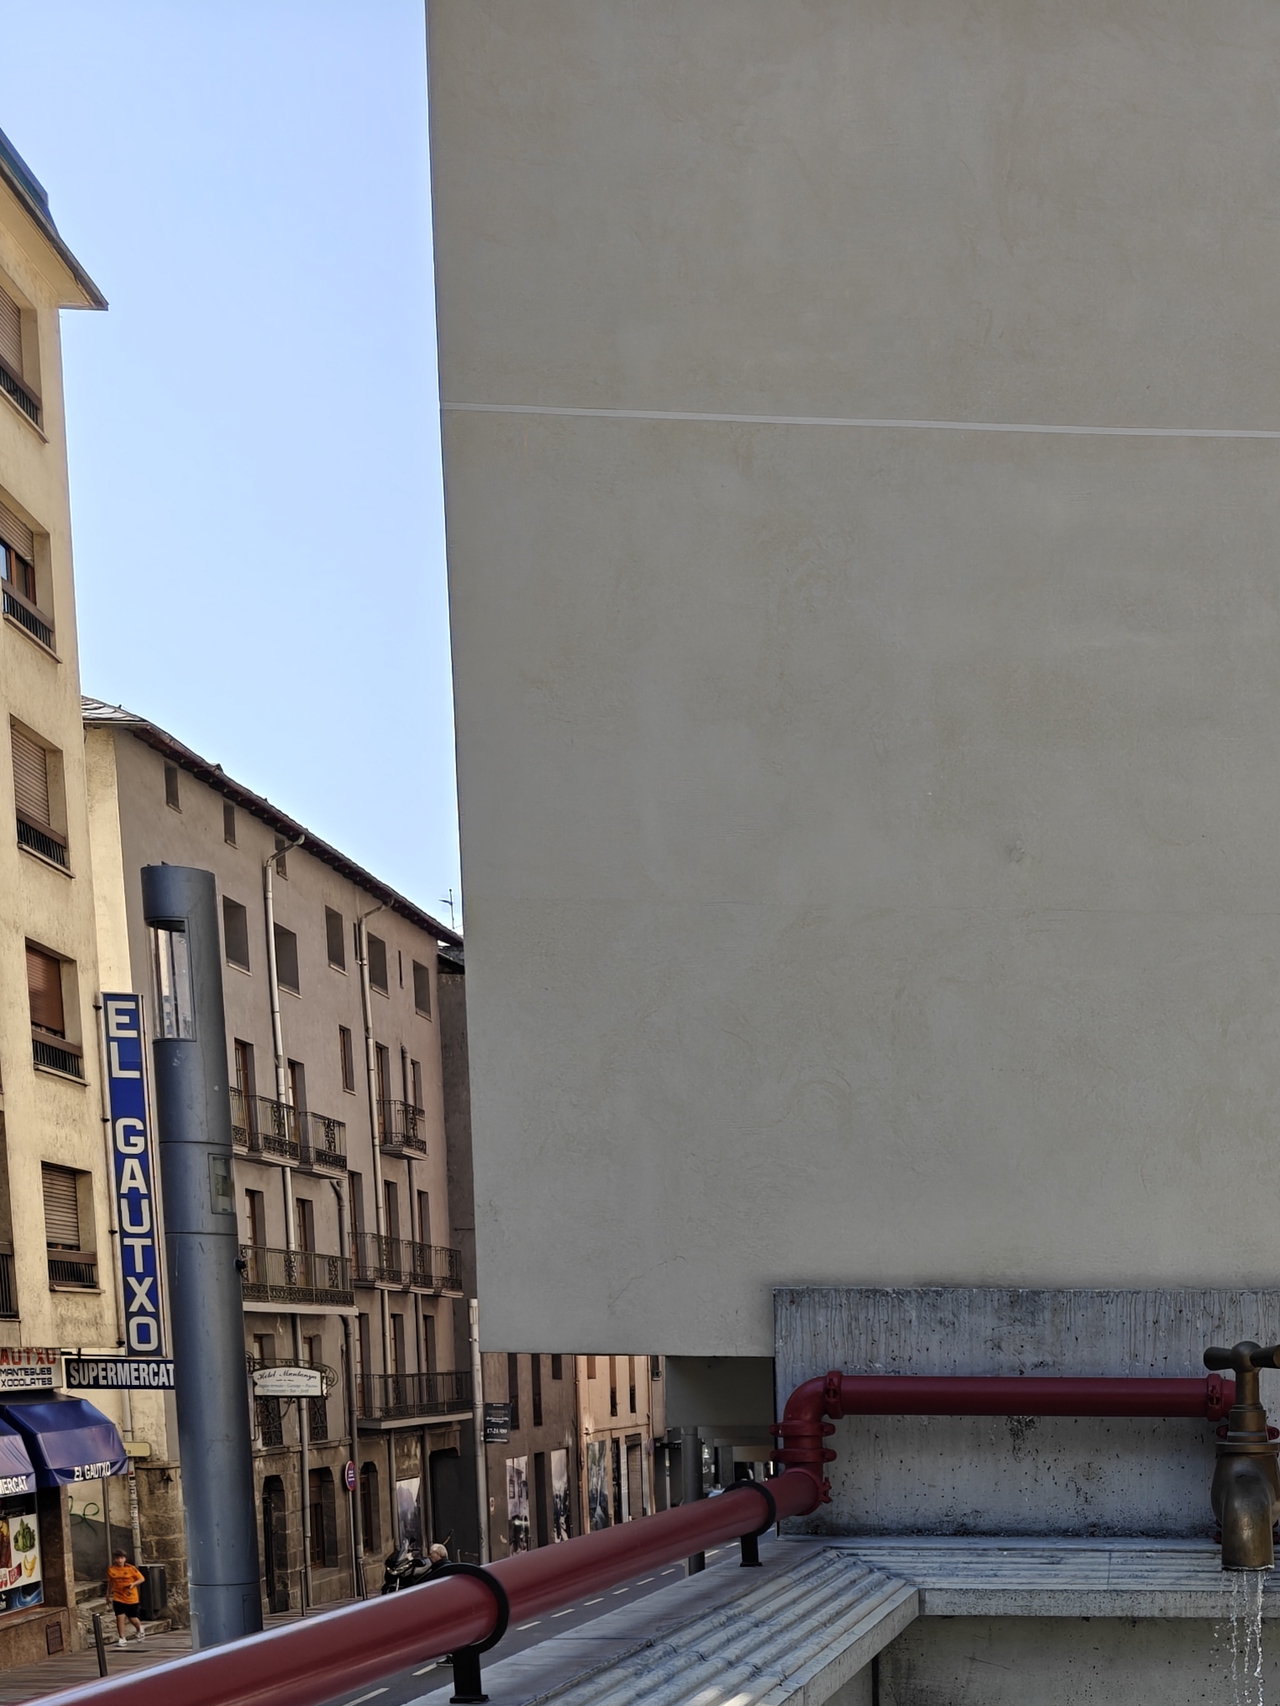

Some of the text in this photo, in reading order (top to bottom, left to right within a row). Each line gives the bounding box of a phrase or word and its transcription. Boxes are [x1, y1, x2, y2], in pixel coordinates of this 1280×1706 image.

[107, 1000, 159, 1351] EL GAUTXO
[1, 1377, 53, 1388] XOCOLATES
[69, 1361, 175, 1387] SUPERMERCAT
[73, 1461, 112, 1482] EL GAUTXO
